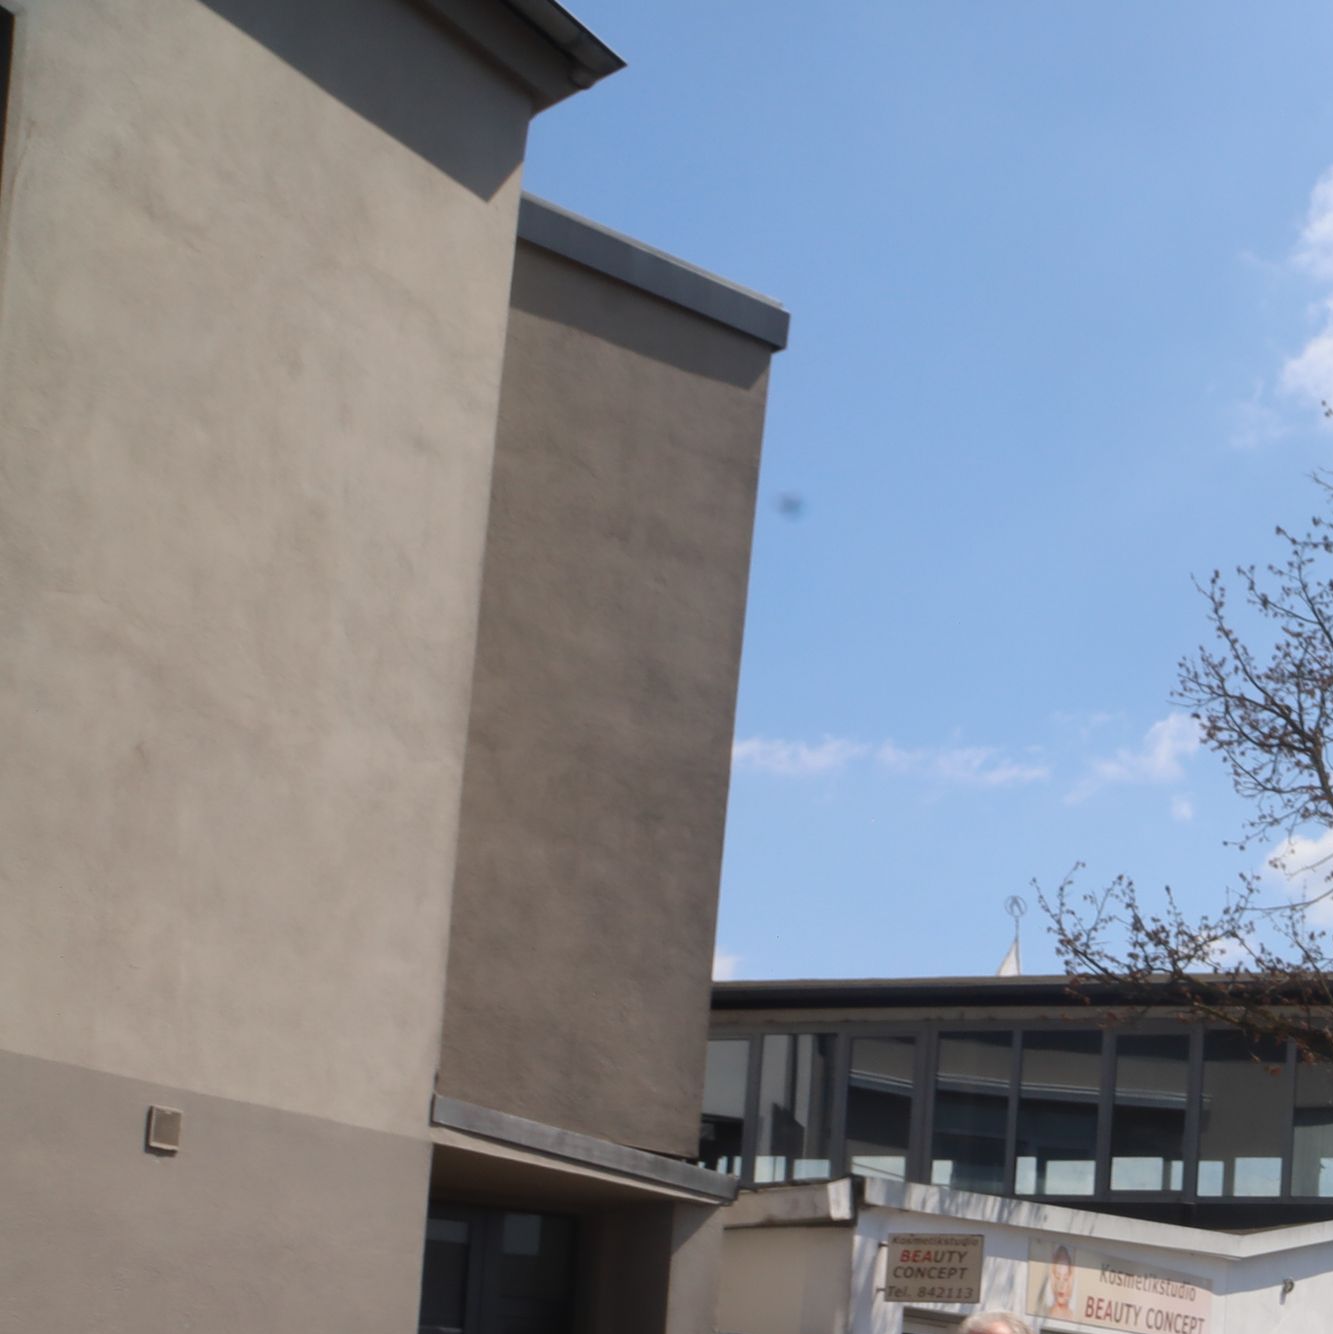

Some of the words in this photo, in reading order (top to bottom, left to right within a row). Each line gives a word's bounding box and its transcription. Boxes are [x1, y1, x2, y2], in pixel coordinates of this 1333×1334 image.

[892, 1237, 979, 1246] Kosmetikstudio
[900, 1249, 968, 1263] BEAUTY
[893, 1266, 968, 1279] CONCEPT
[1099, 1263, 1198, 1302] Kosmetikstudio
[887, 1285, 912, 1298] Tel.
[917, 1286, 974, 1299] 842113
[1084, 1295, 1142, 1326] BEAUTY
